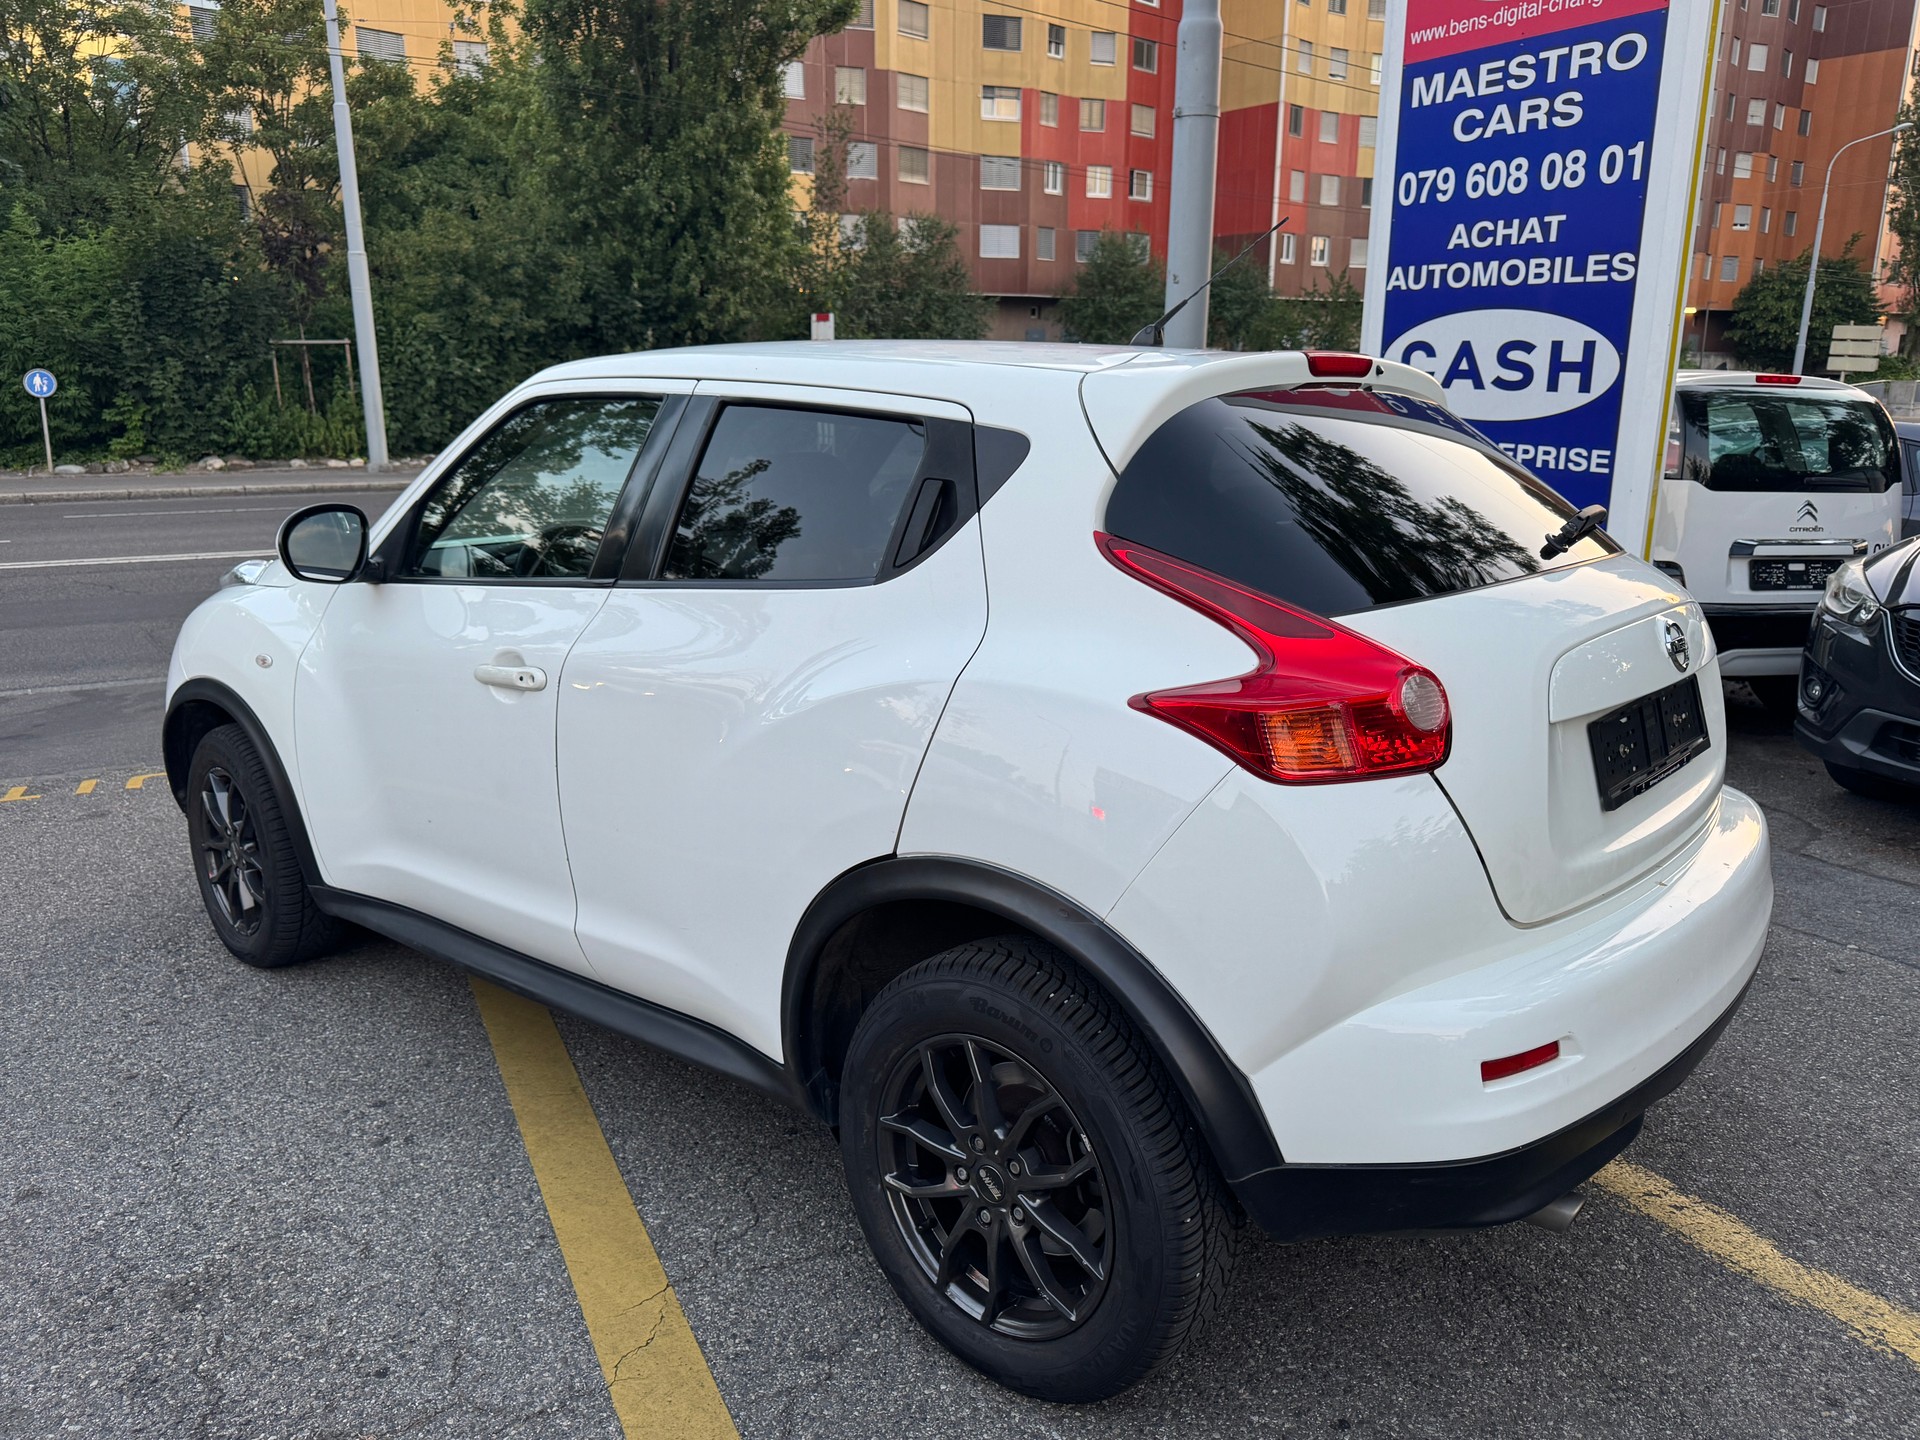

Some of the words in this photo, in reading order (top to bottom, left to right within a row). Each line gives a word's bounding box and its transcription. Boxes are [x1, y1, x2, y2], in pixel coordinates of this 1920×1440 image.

[1411, 33, 1648, 108] MAESTRO
[1453, 91, 1584, 142] CARS
[1399, 166, 1456, 207] 079
[1465, 156, 1529, 199] 608
[1540, 149, 1587, 191] 08
[1600, 140, 1645, 185] 01
[1447, 214, 1567, 250] ACHAT
[1386, 252, 1637, 292] AUTOMOBILES
[1401, 340, 1596, 393] CASH
